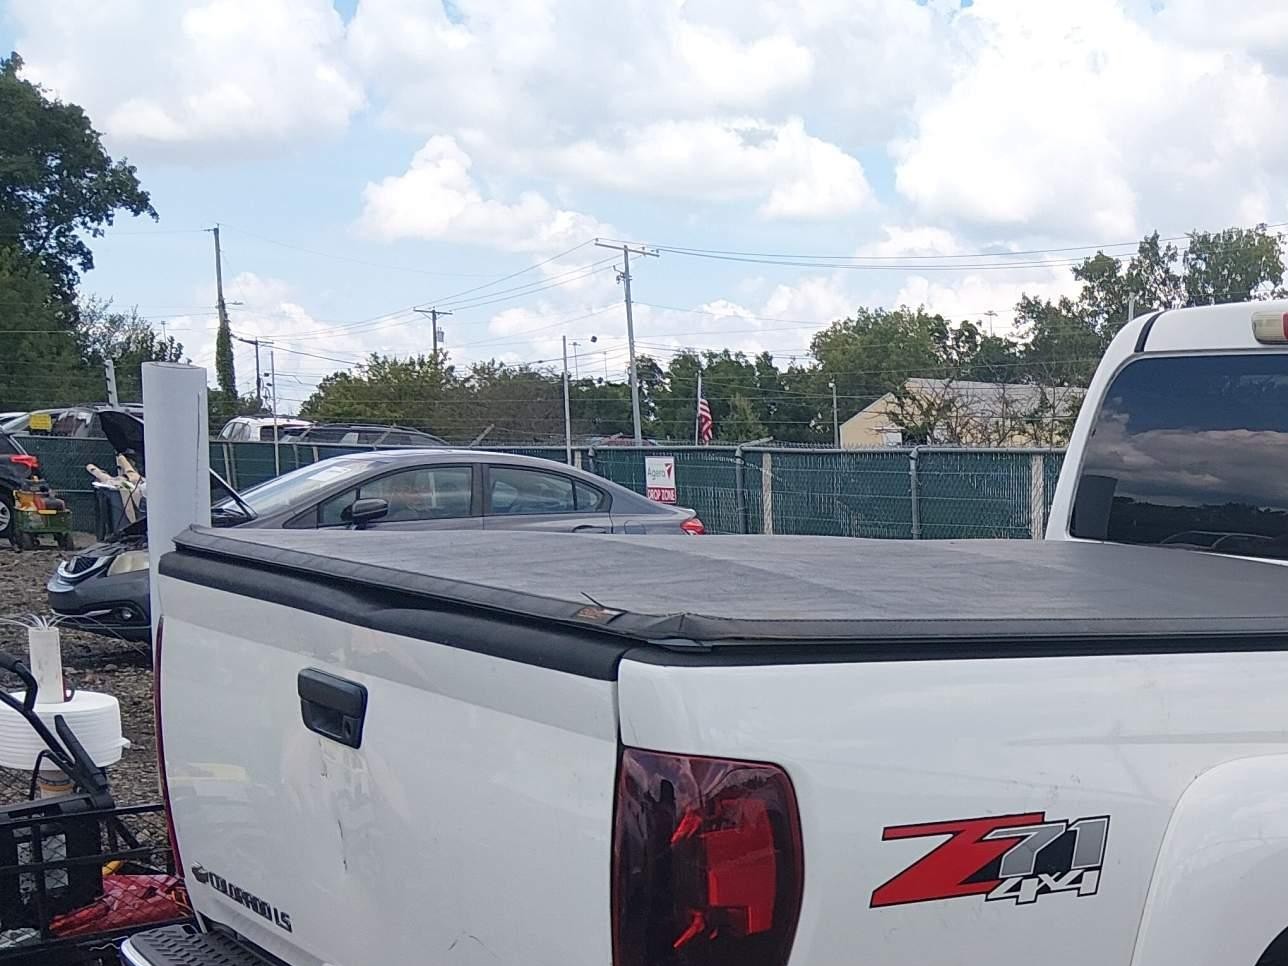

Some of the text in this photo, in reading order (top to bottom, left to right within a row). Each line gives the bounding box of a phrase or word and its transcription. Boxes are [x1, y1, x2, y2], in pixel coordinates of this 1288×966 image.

[647, 488, 676, 501] DROP ZONE
[869, 811, 1110, 908] Z71
[207, 870, 293, 933] COLORADO LS
